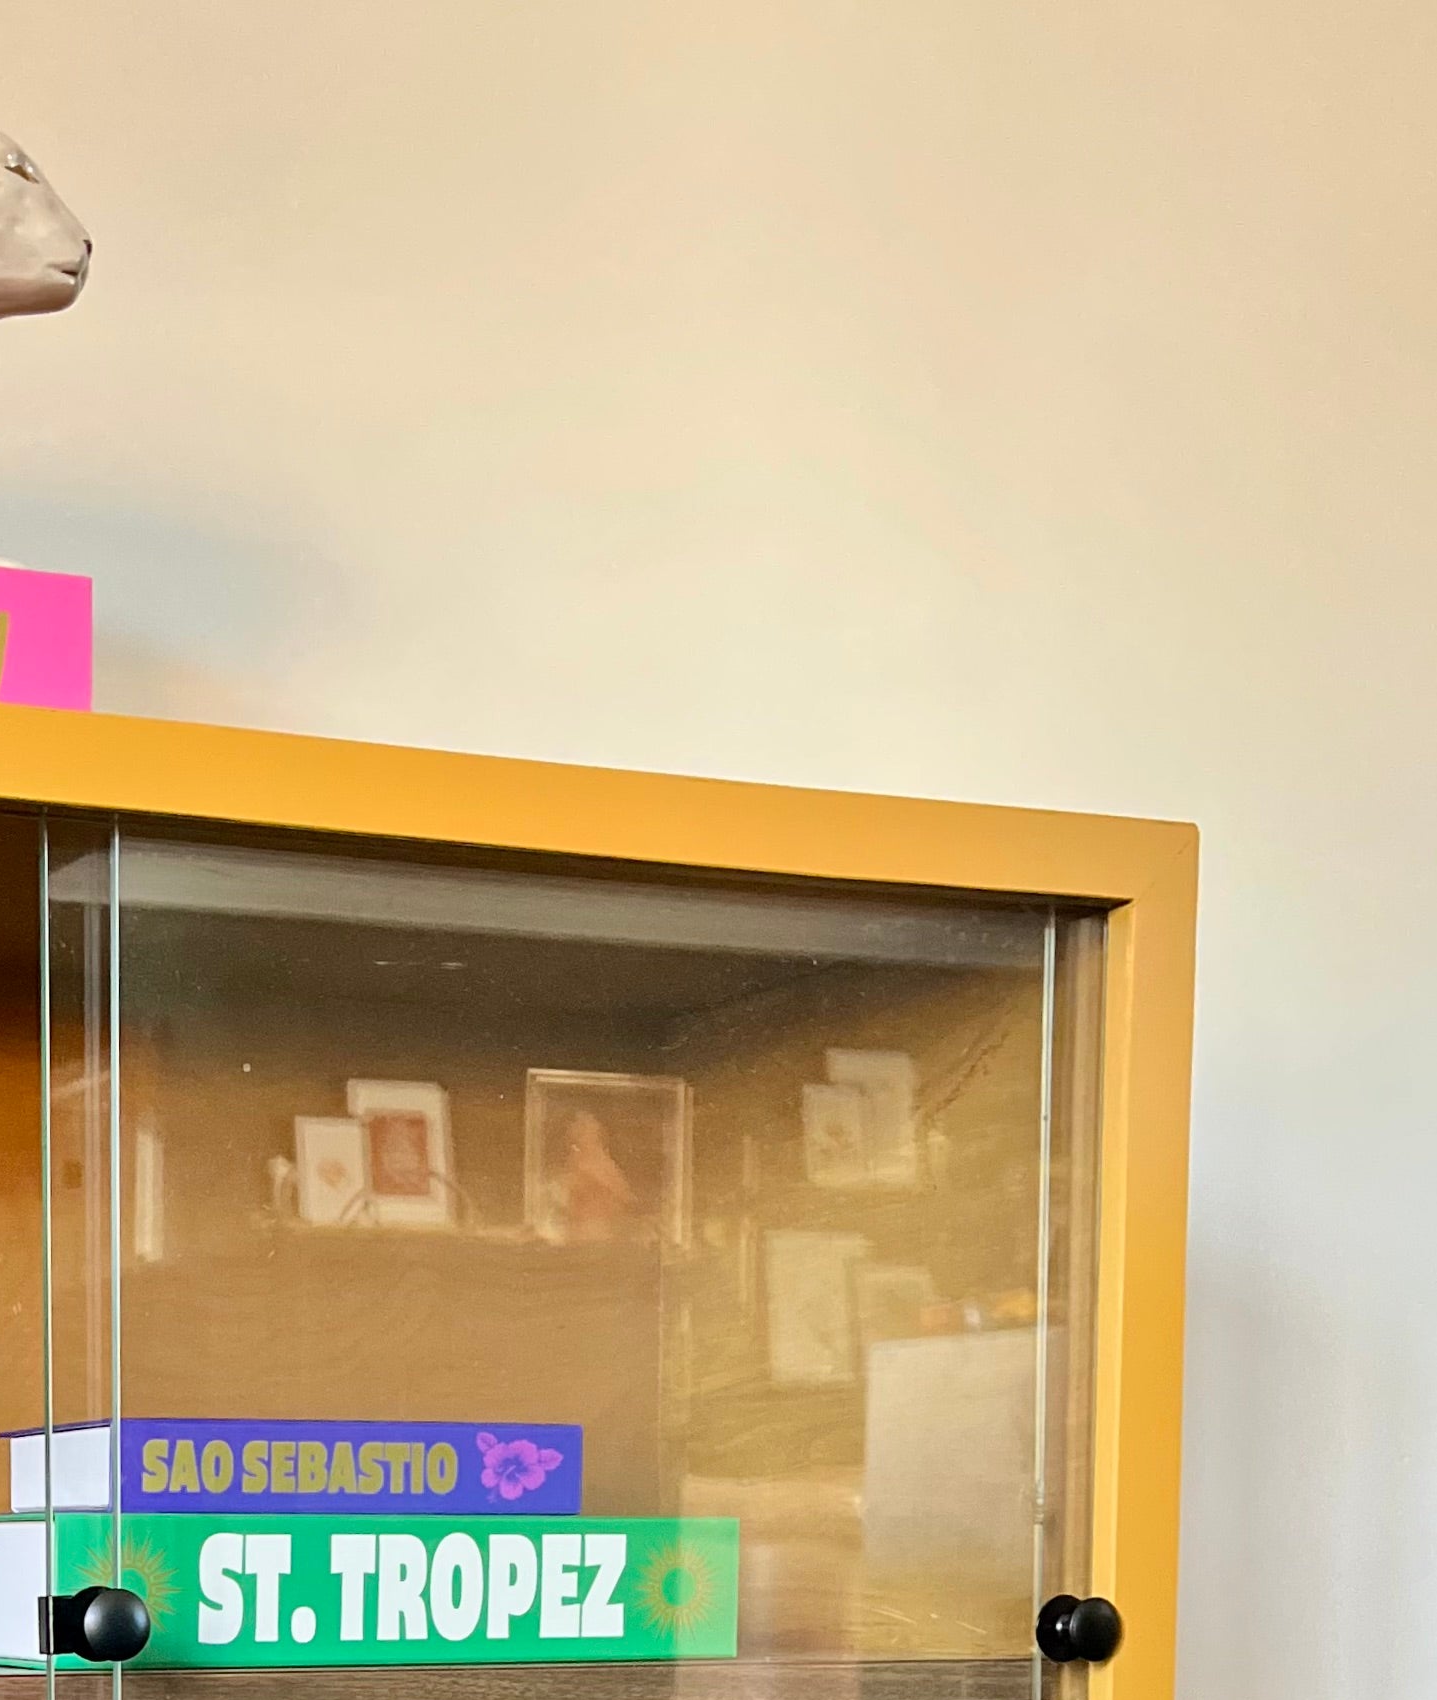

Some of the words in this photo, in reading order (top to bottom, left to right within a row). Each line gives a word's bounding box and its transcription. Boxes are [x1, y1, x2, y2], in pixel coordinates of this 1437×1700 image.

[142, 1439, 233, 1494] SAO
[242, 1441, 457, 1494] SEBASTIO
[197, 1532, 317, 1645] ST.
[330, 1532, 627, 1641] TROPEZ
